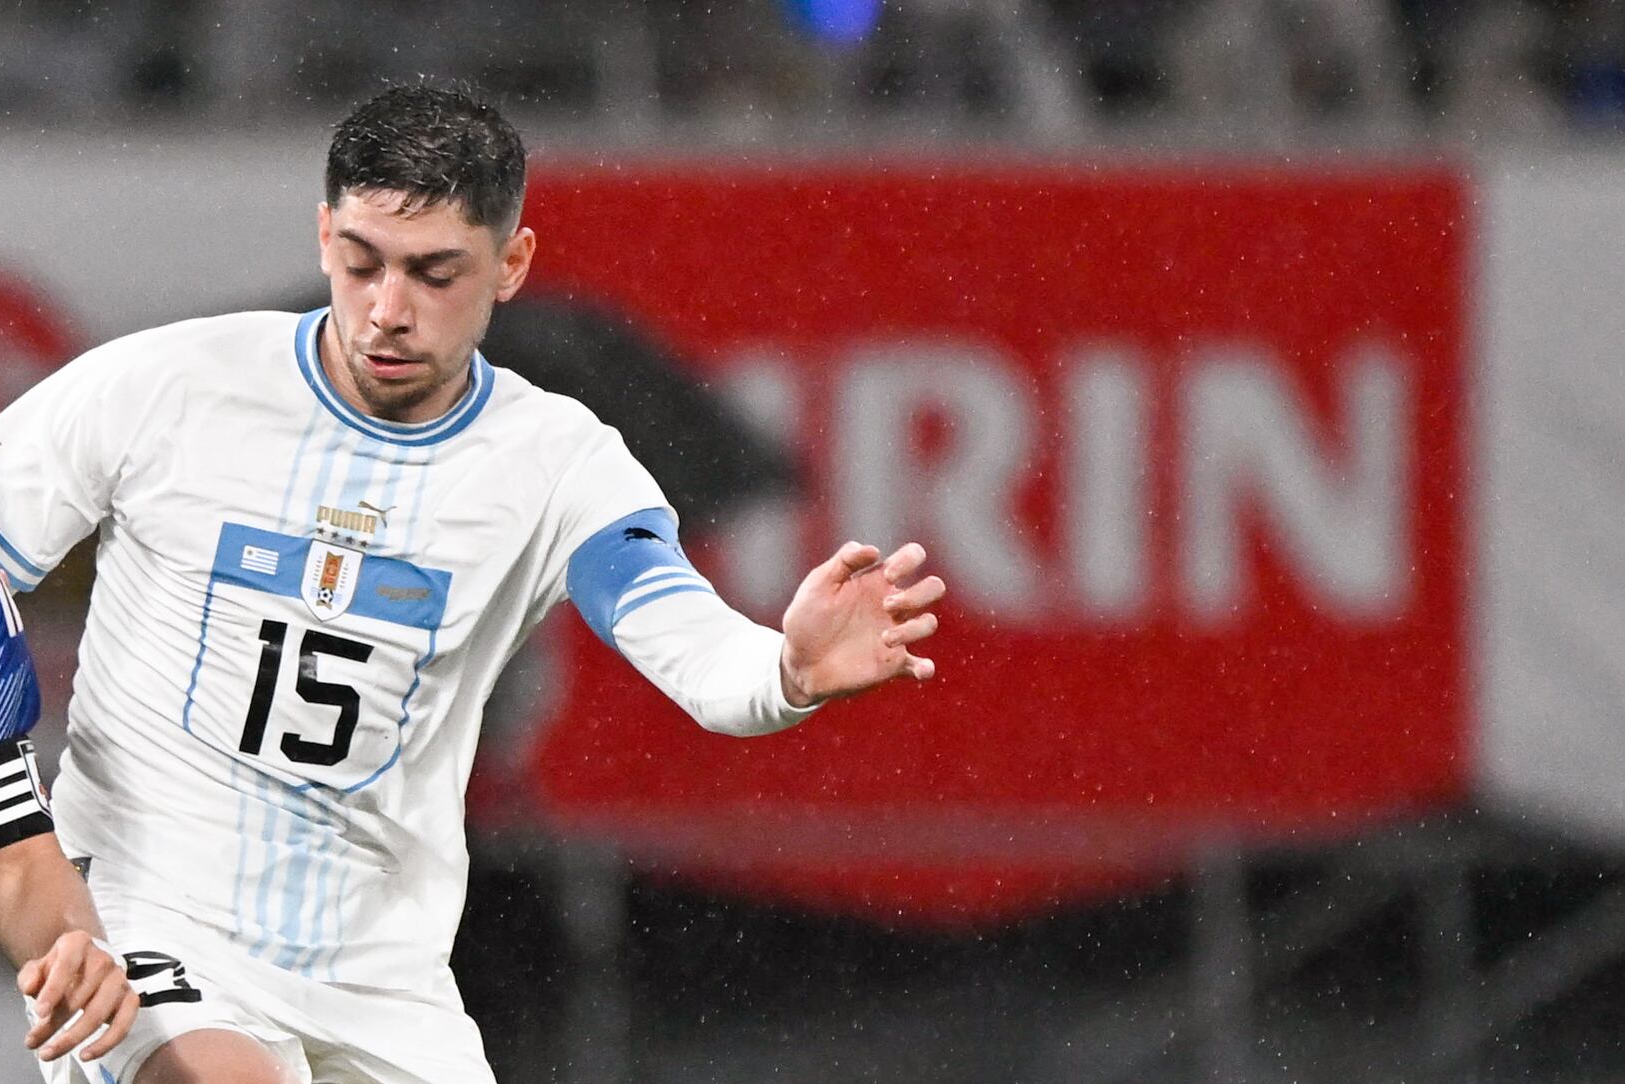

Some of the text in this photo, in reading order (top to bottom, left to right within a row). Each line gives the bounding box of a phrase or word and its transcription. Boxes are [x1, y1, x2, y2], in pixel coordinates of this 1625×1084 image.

[316, 505, 377, 534] PUMA
[715, 338, 1415, 620] IRIN
[239, 619, 375, 767] 15
